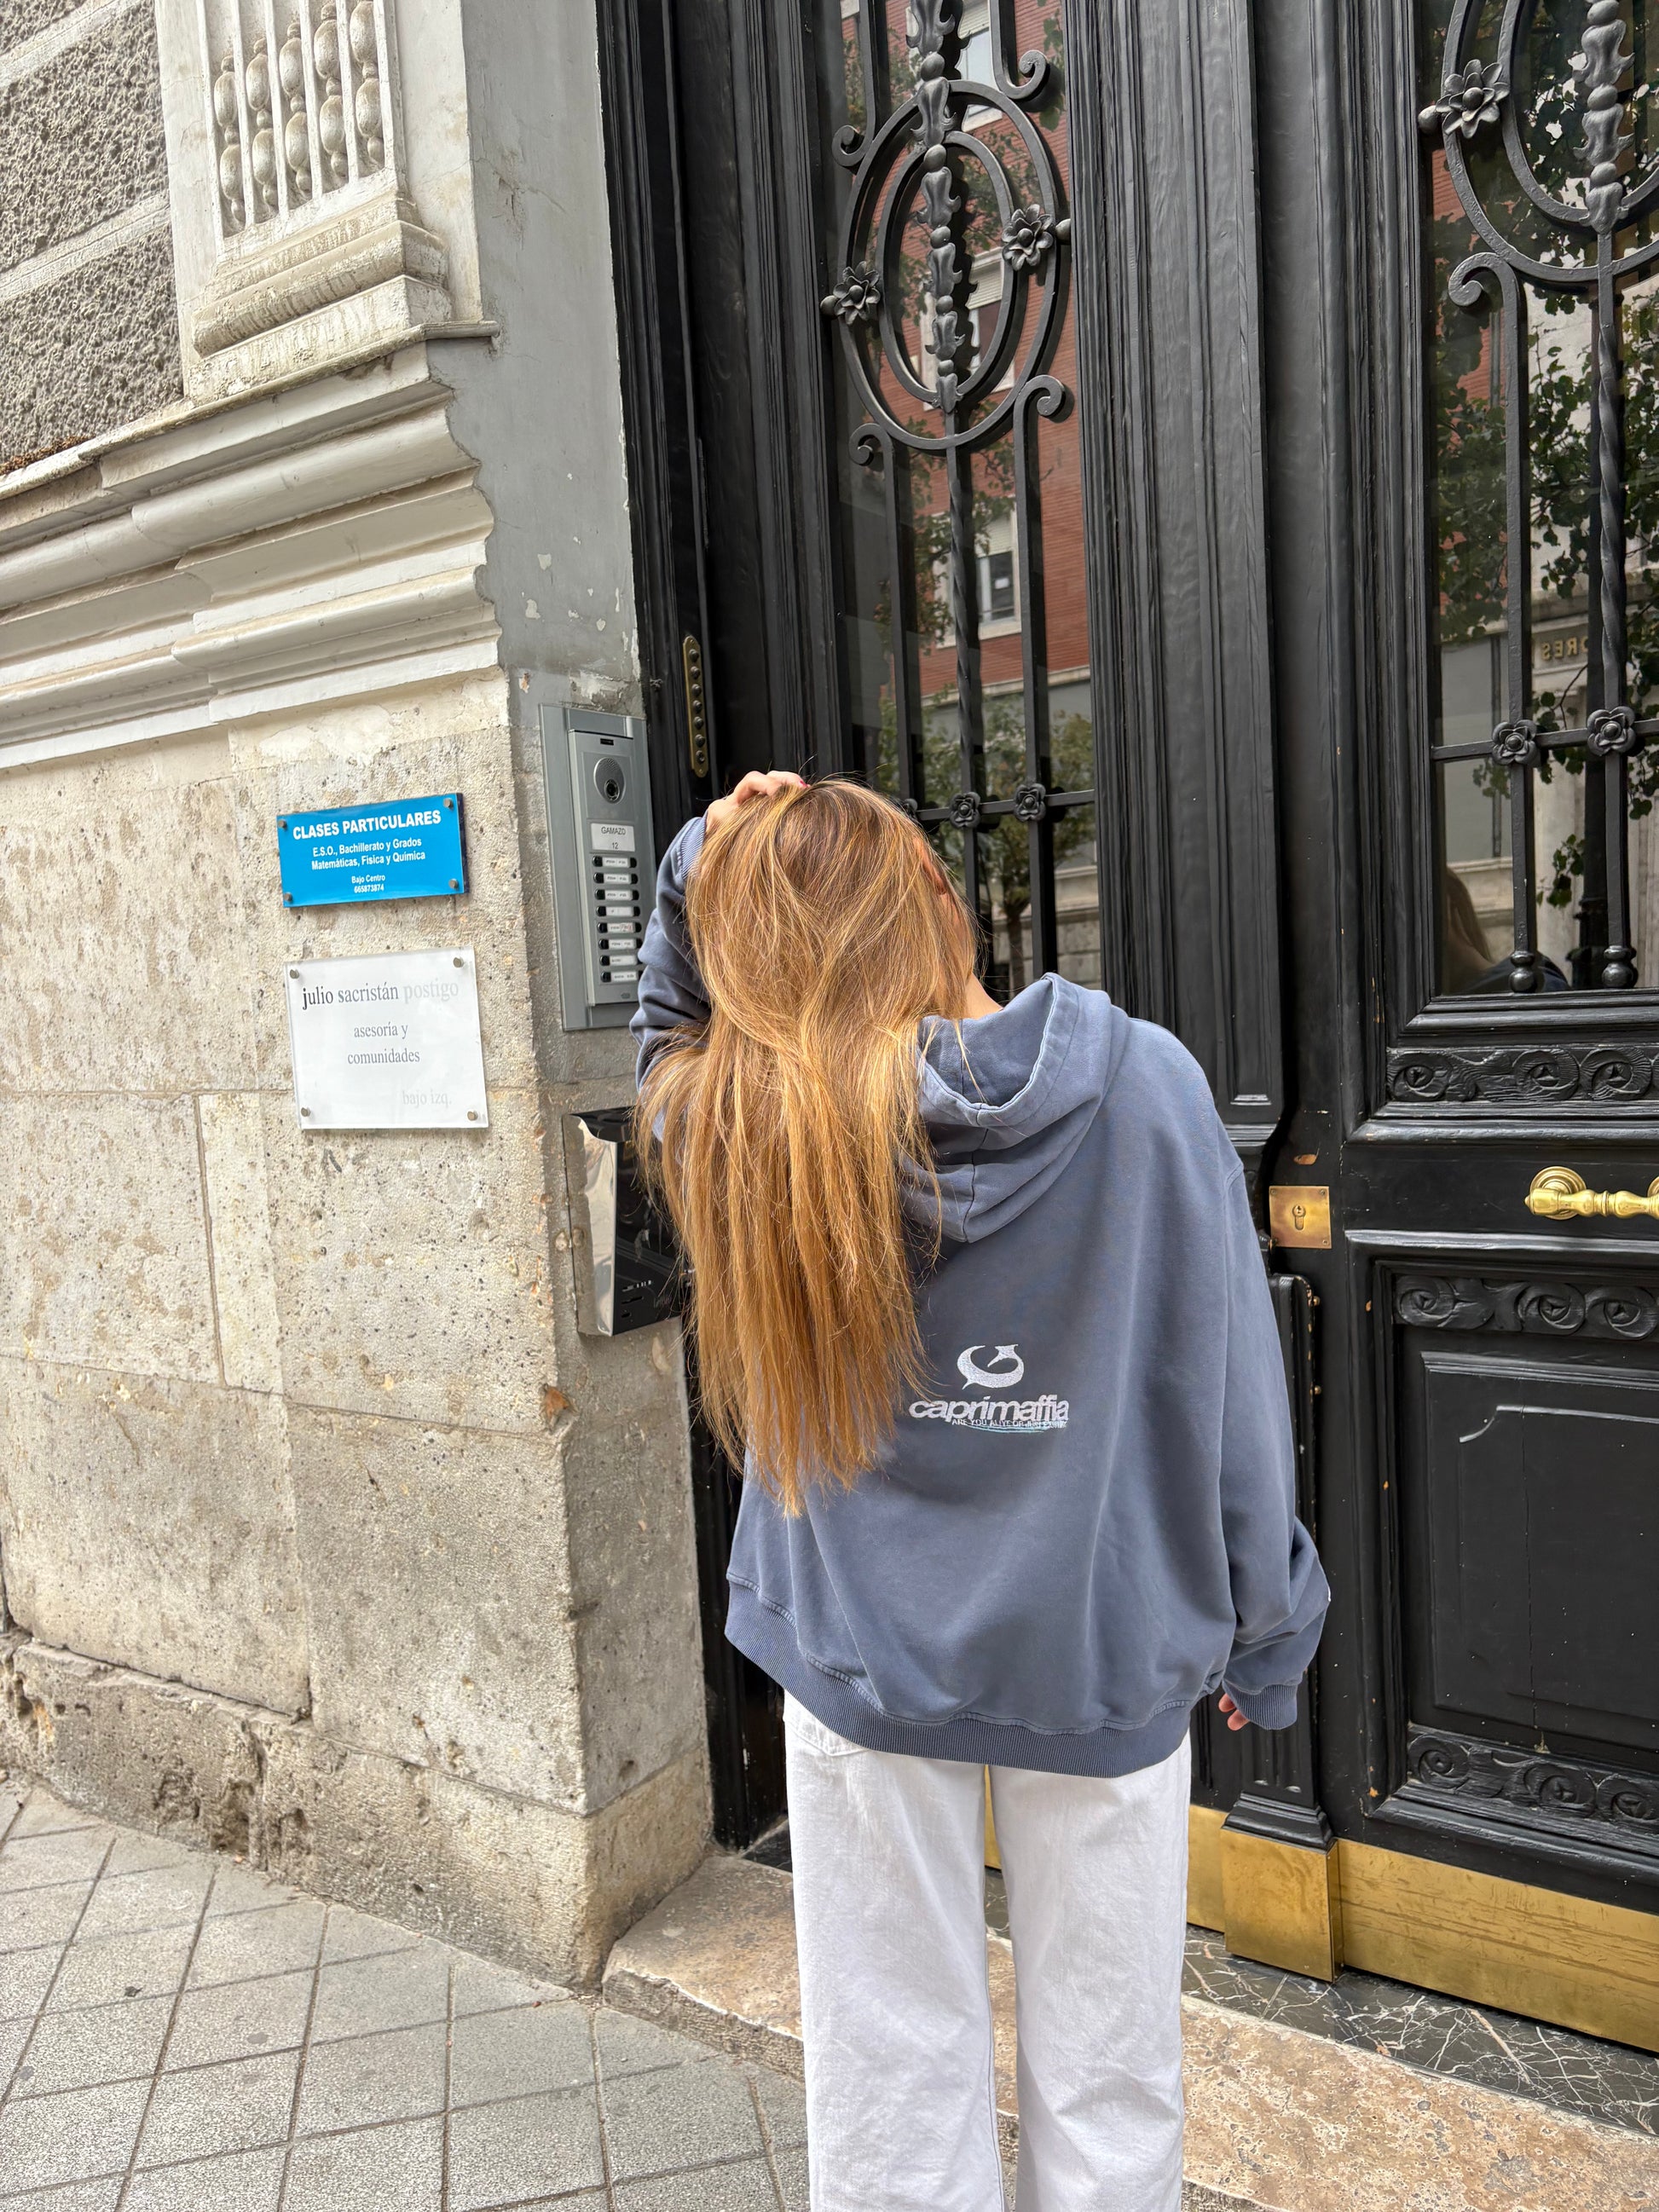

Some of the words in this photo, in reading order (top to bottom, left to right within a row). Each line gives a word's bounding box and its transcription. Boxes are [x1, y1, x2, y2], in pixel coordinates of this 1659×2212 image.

[292, 822, 339, 840] CLASES
[343, 810, 442, 834] PARTICULARES
[601, 826, 627, 835] GAMAZO
[313, 846, 338, 858] E.S.O.,
[339, 840, 384, 854] Bachillerato
[386, 841, 391, 851] y
[393, 837, 422, 849] Grados
[311, 858, 360, 870] Matemáticas,
[361, 854, 384, 865] Física
[386, 856, 391, 865] y
[393, 850, 426, 863] Química
[351, 875, 365, 885] Bajo
[366, 874, 386, 883] Centro
[302, 985, 334, 1010] julio
[338, 982, 399, 1003] sacristán
[403, 978, 460, 1004] postigo
[354, 1021, 399, 1037] asesoría
[401, 1024, 408, 1039] y
[347, 1048, 420, 1065] comunidades
[402, 1089, 427, 1108] bajo
[430, 1089, 452, 1108] izq.
[908, 1394, 1070, 1422] caprimaffia
